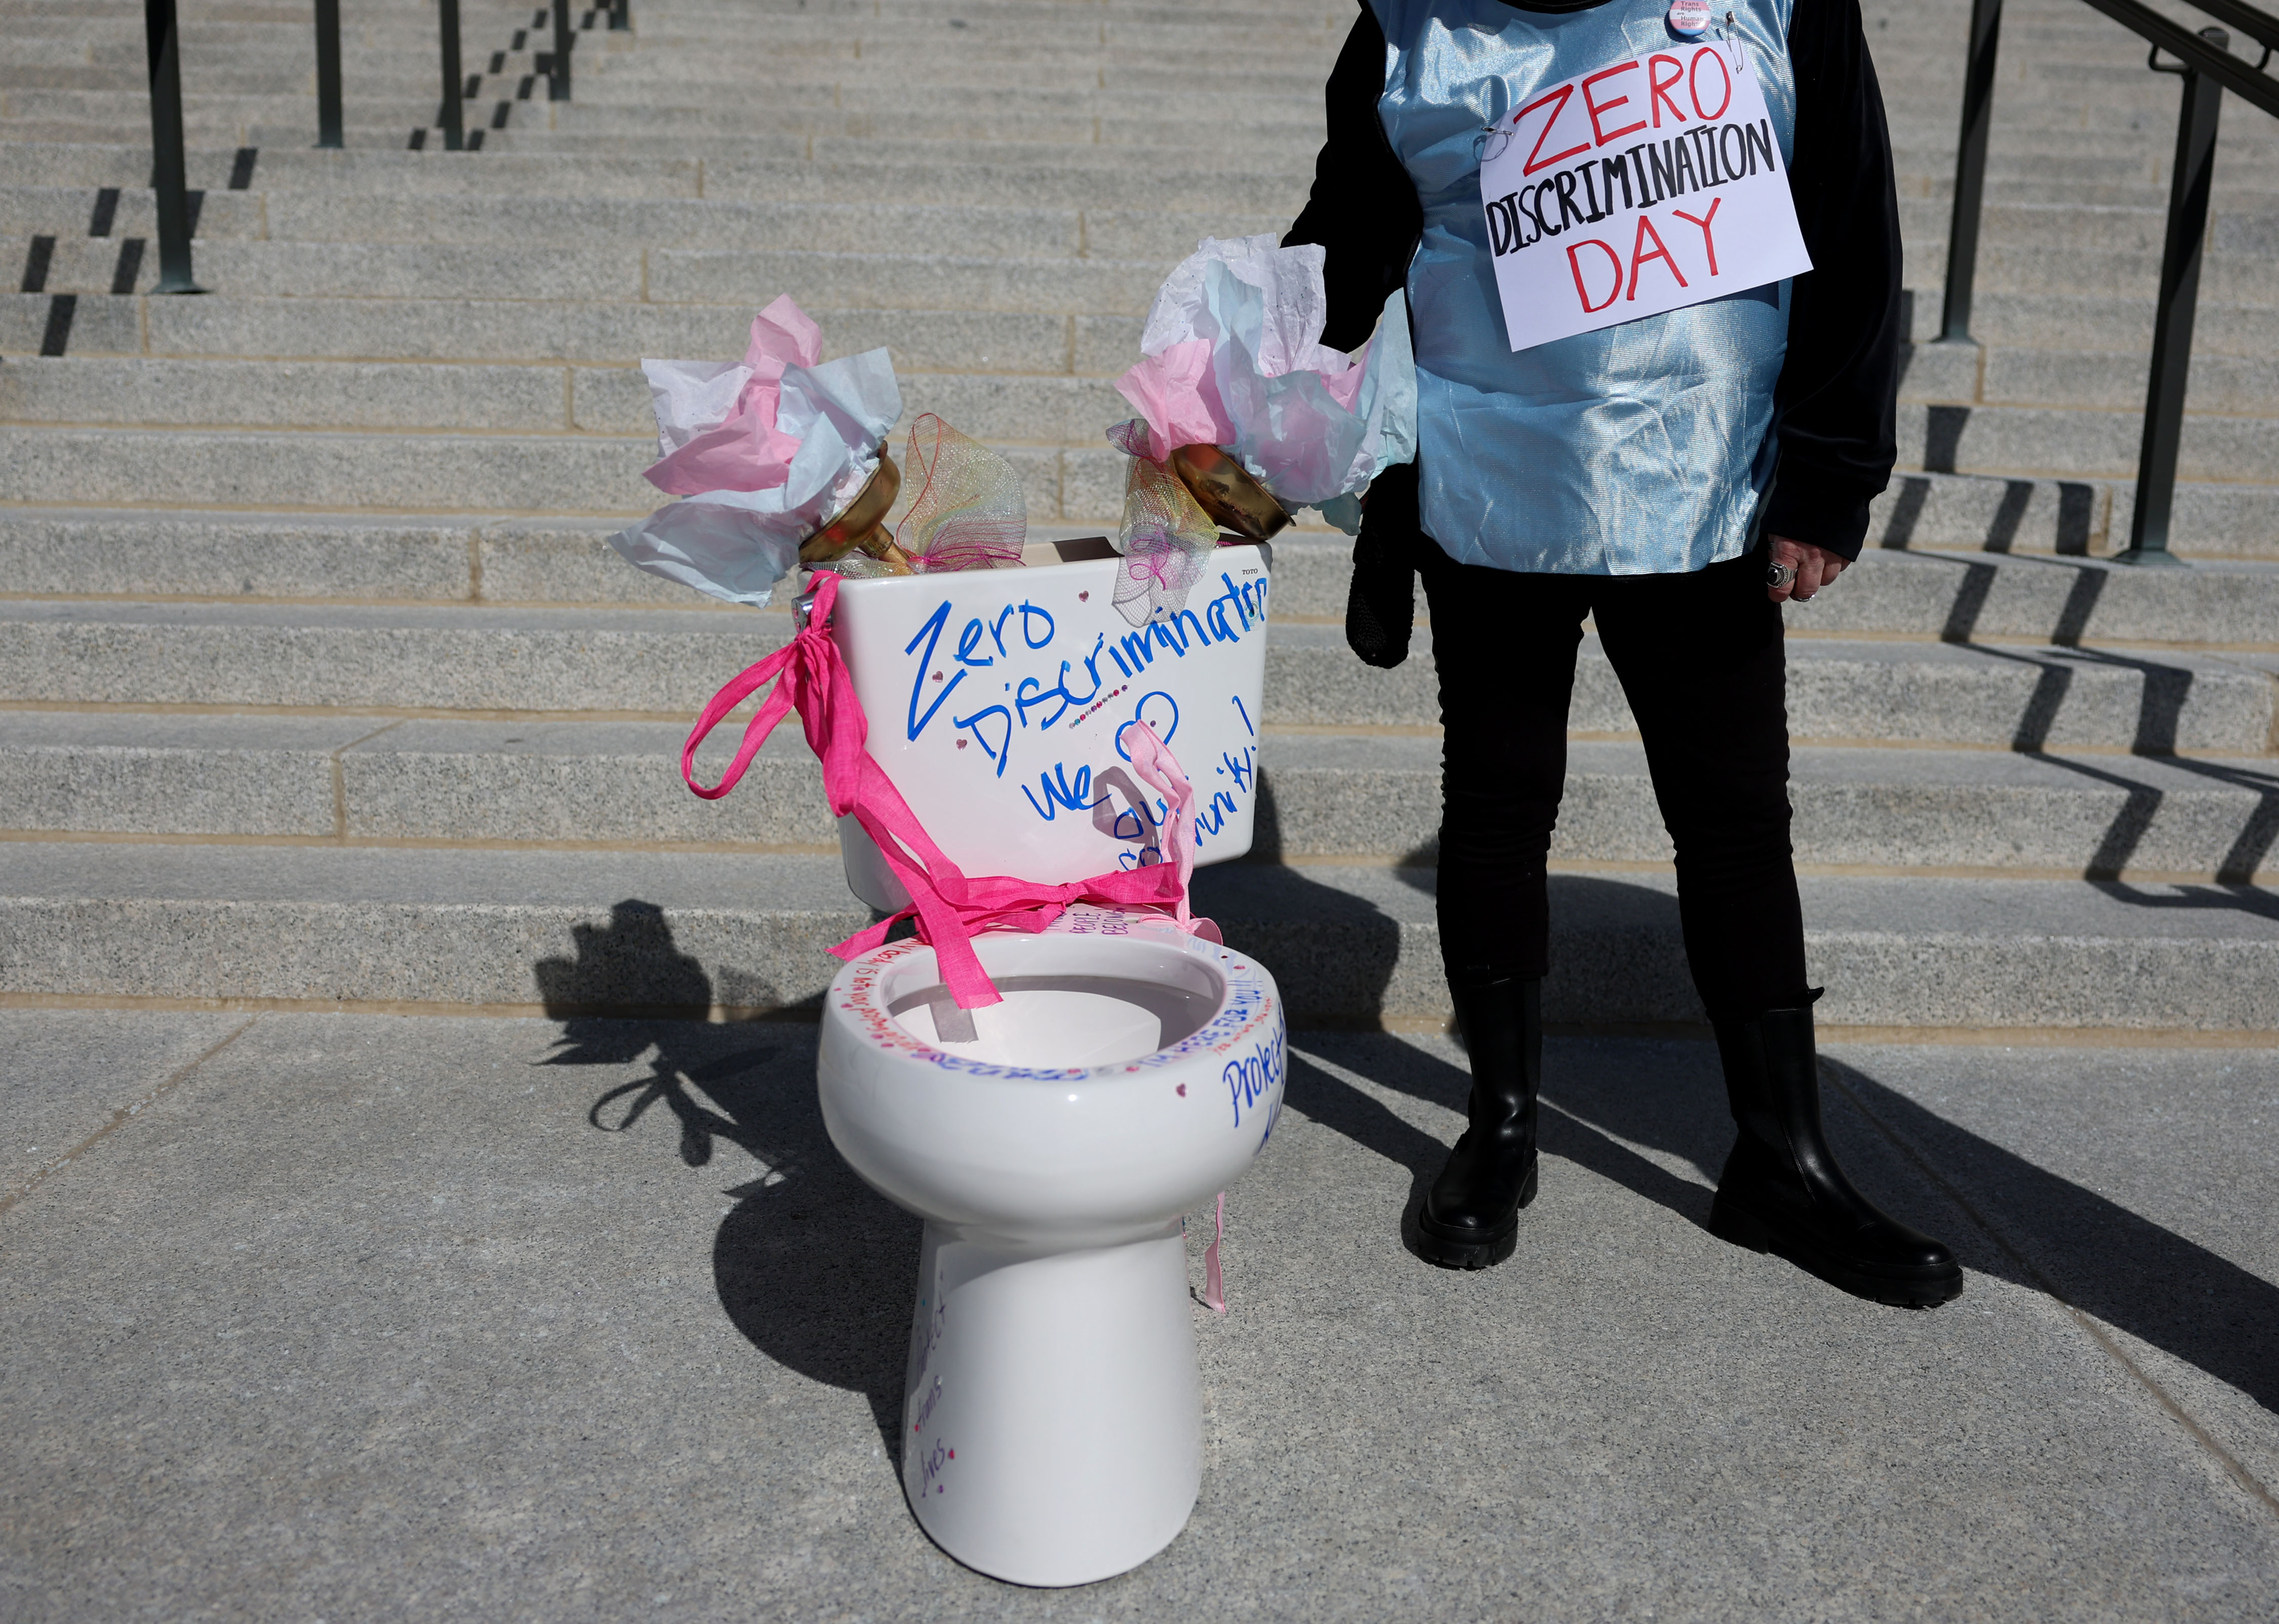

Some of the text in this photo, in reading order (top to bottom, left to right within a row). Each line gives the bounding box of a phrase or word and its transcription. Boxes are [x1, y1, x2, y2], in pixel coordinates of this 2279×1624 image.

[1513, 47, 1732, 177] ZERO
[1485, 118, 1775, 257] DISCRIMINATION
[1566, 197, 1721, 313] DAY
[905, 599, 1055, 742] Zero
[1021, 762, 1112, 821] We
[1069, 913, 1102, 933] PEOPLE
